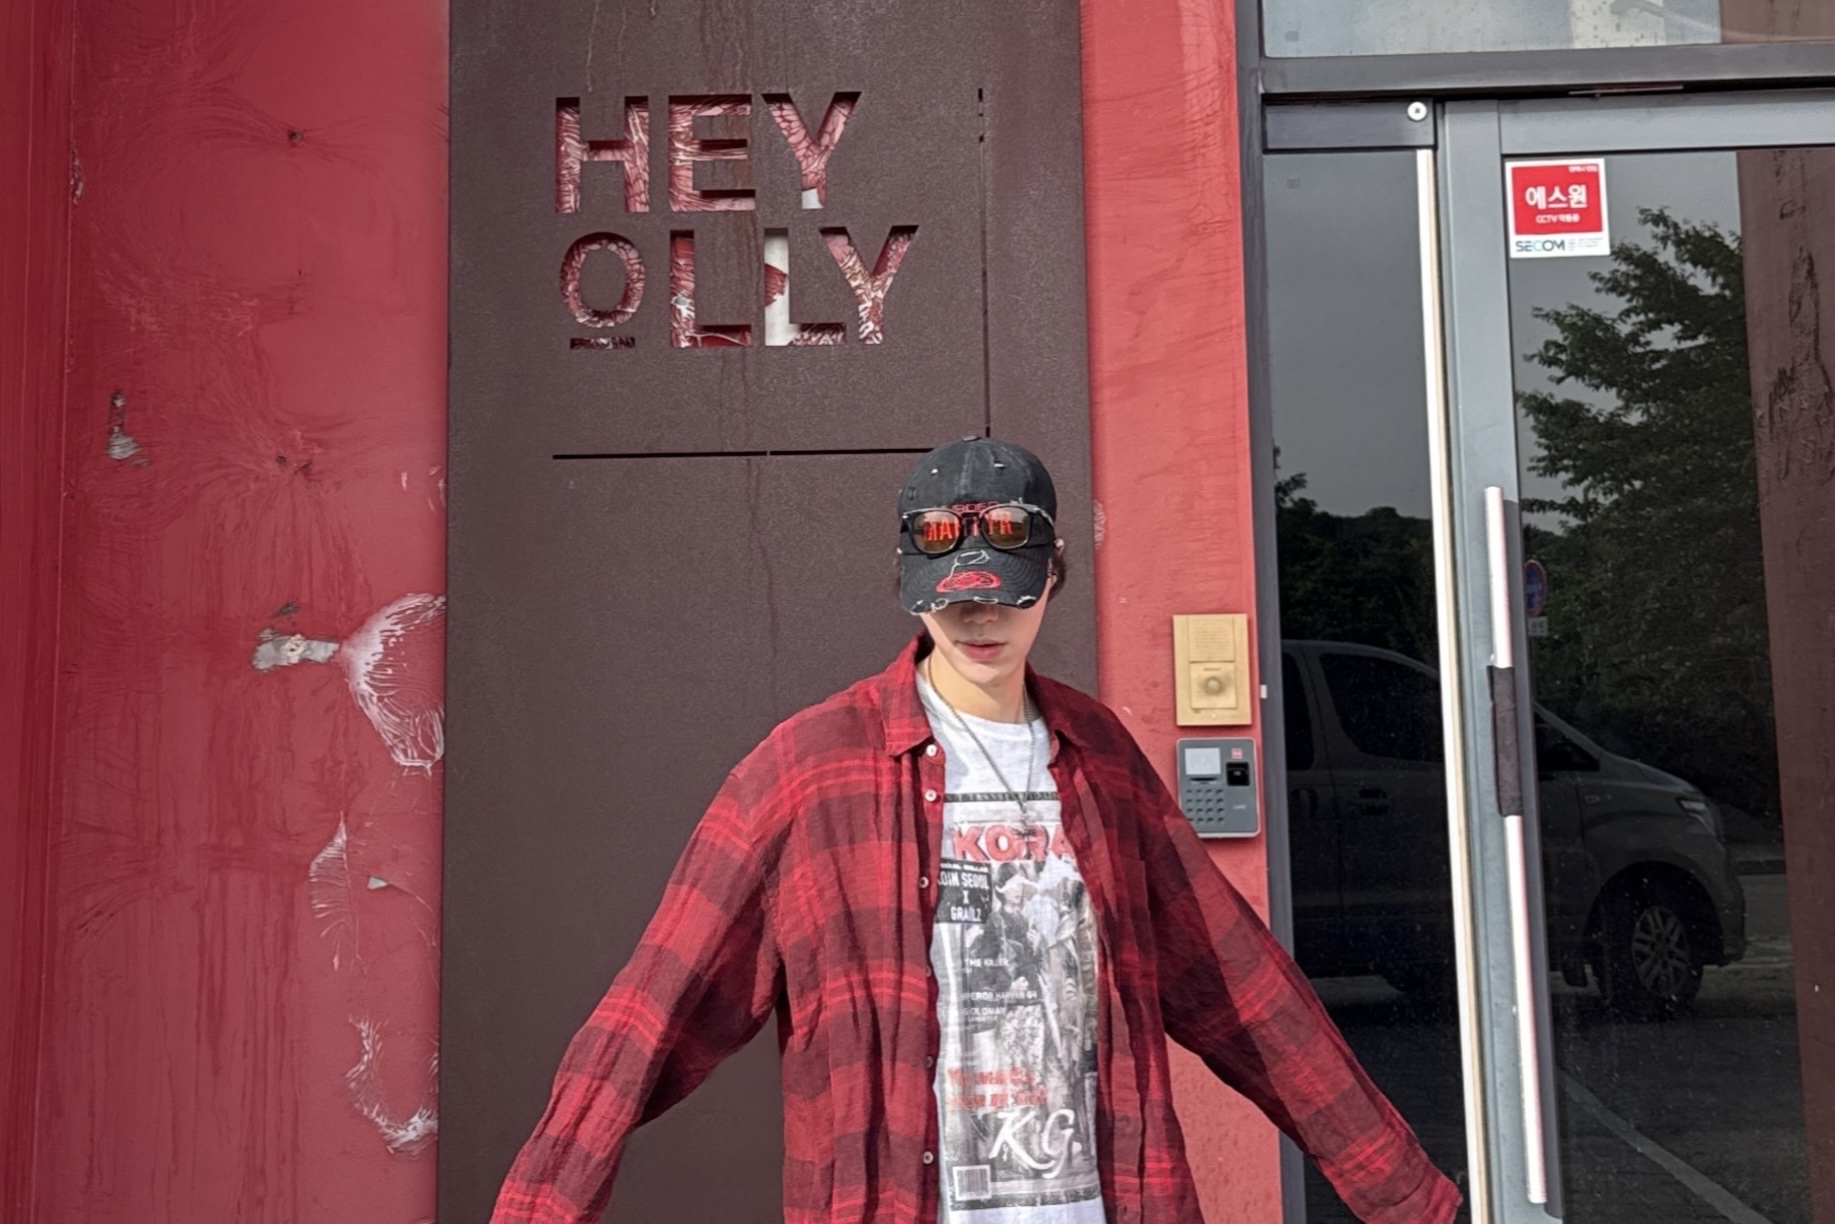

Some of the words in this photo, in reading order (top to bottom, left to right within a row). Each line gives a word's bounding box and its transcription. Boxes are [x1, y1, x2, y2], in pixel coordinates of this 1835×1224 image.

[556, 92, 862, 213] HEY
[1525, 184, 1588, 210] 에스원
[1515, 239, 1566, 252] SECOM
[560, 225, 919, 348] OLLY
